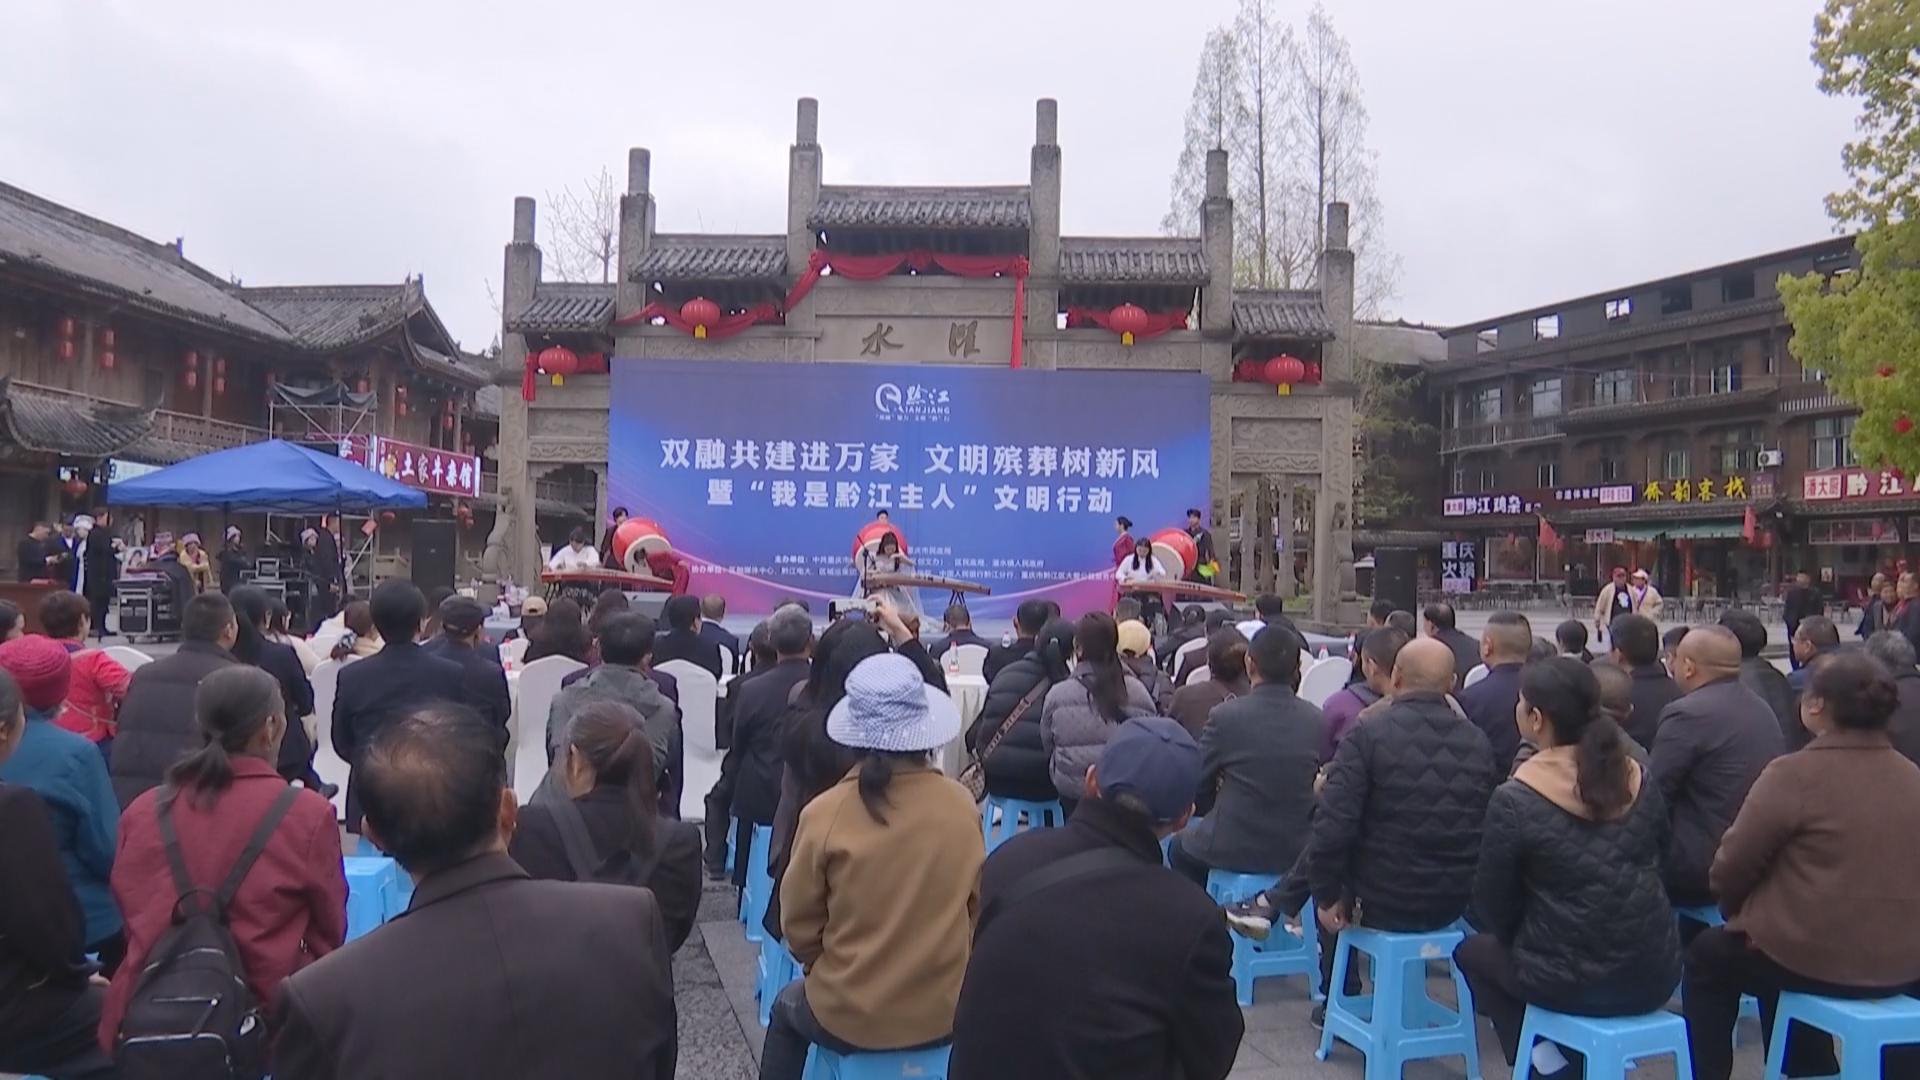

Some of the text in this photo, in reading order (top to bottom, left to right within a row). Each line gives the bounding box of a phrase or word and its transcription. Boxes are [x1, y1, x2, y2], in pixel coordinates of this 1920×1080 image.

[660, 438, 1160, 479] 双融共建进万家 文明殡葬树新风
[1442, 541, 1475, 559] 重庆
[1442, 561, 1475, 579] 火锅
